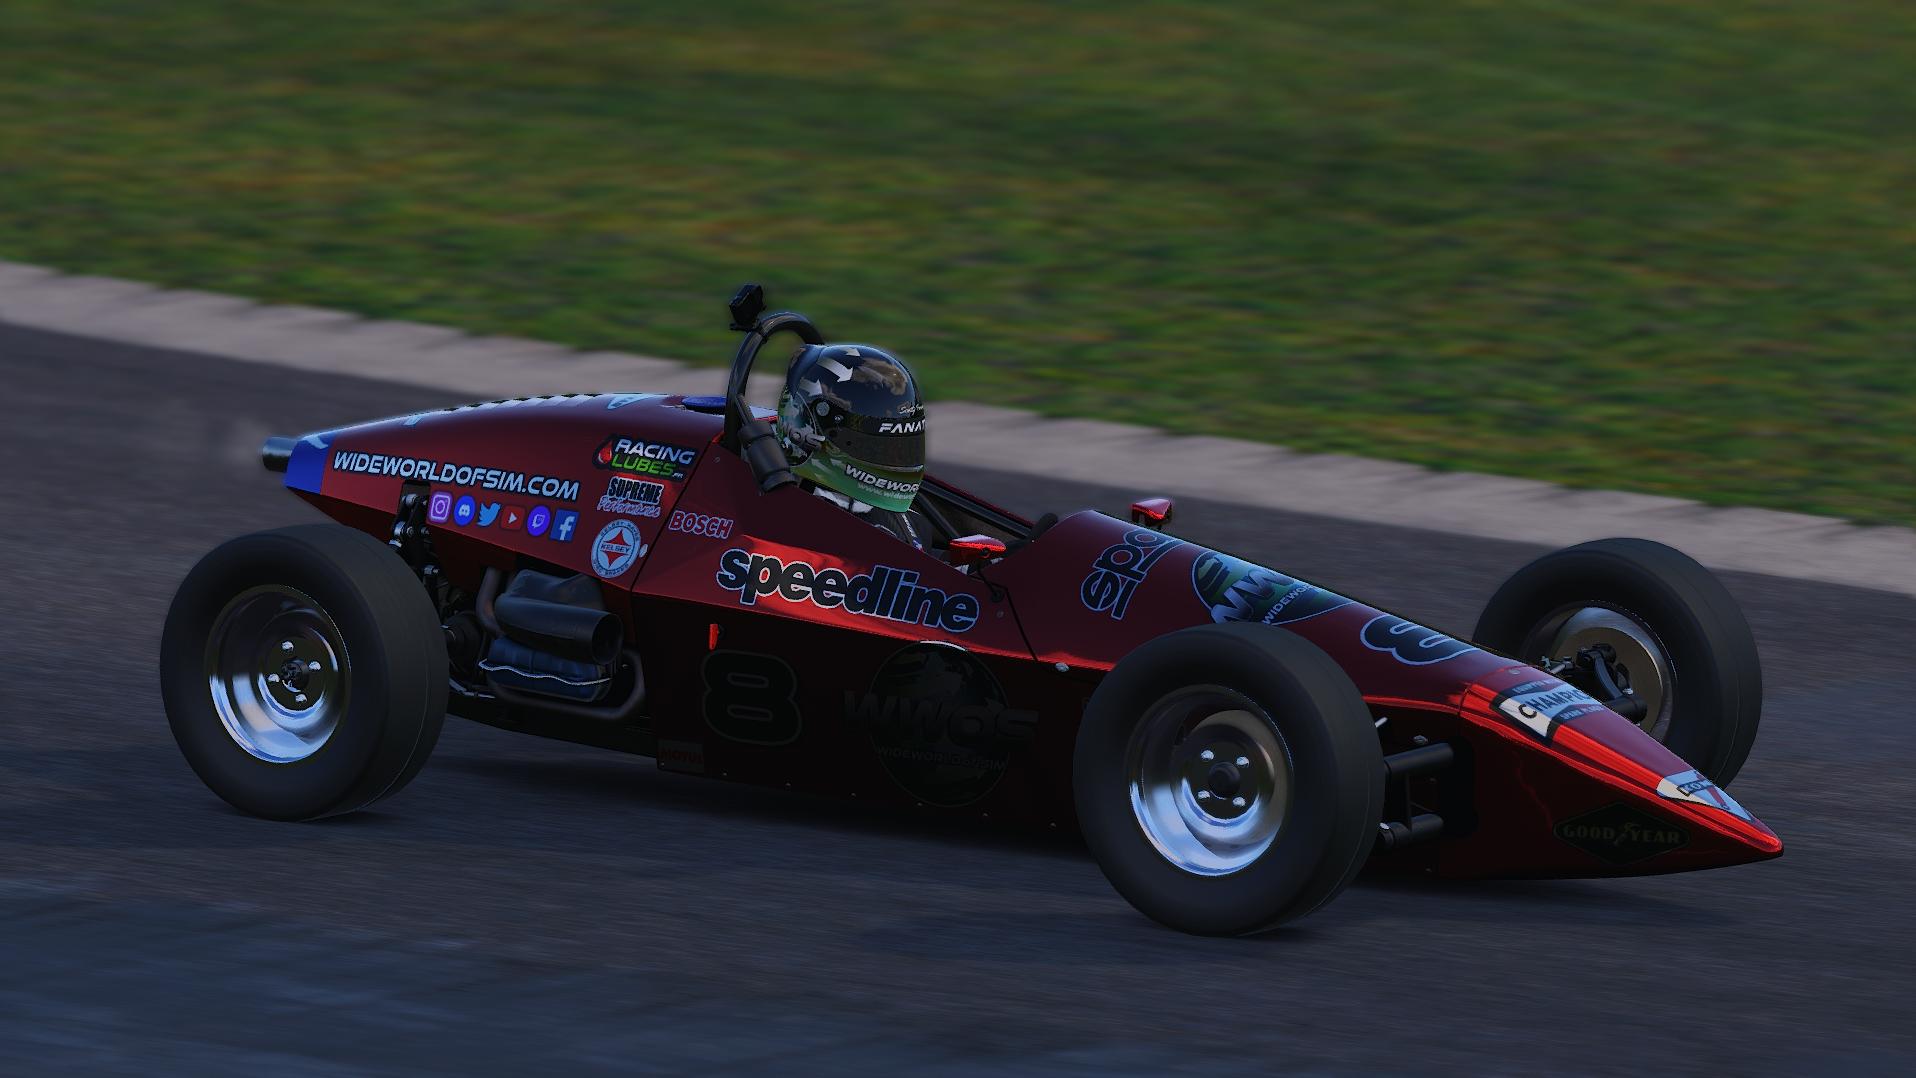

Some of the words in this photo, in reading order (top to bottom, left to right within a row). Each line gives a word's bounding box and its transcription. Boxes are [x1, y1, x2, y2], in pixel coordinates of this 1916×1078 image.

[615, 438, 696, 465] RACING
[333, 450, 581, 502] WIDEWORLDOFSIM.COM
[608, 477, 663, 503] SUPREME
[668, 509, 735, 540] BOSCH
[600, 543, 631, 554] KELSEY
[716, 547, 980, 633] speedline
[701, 648, 803, 747] 8
